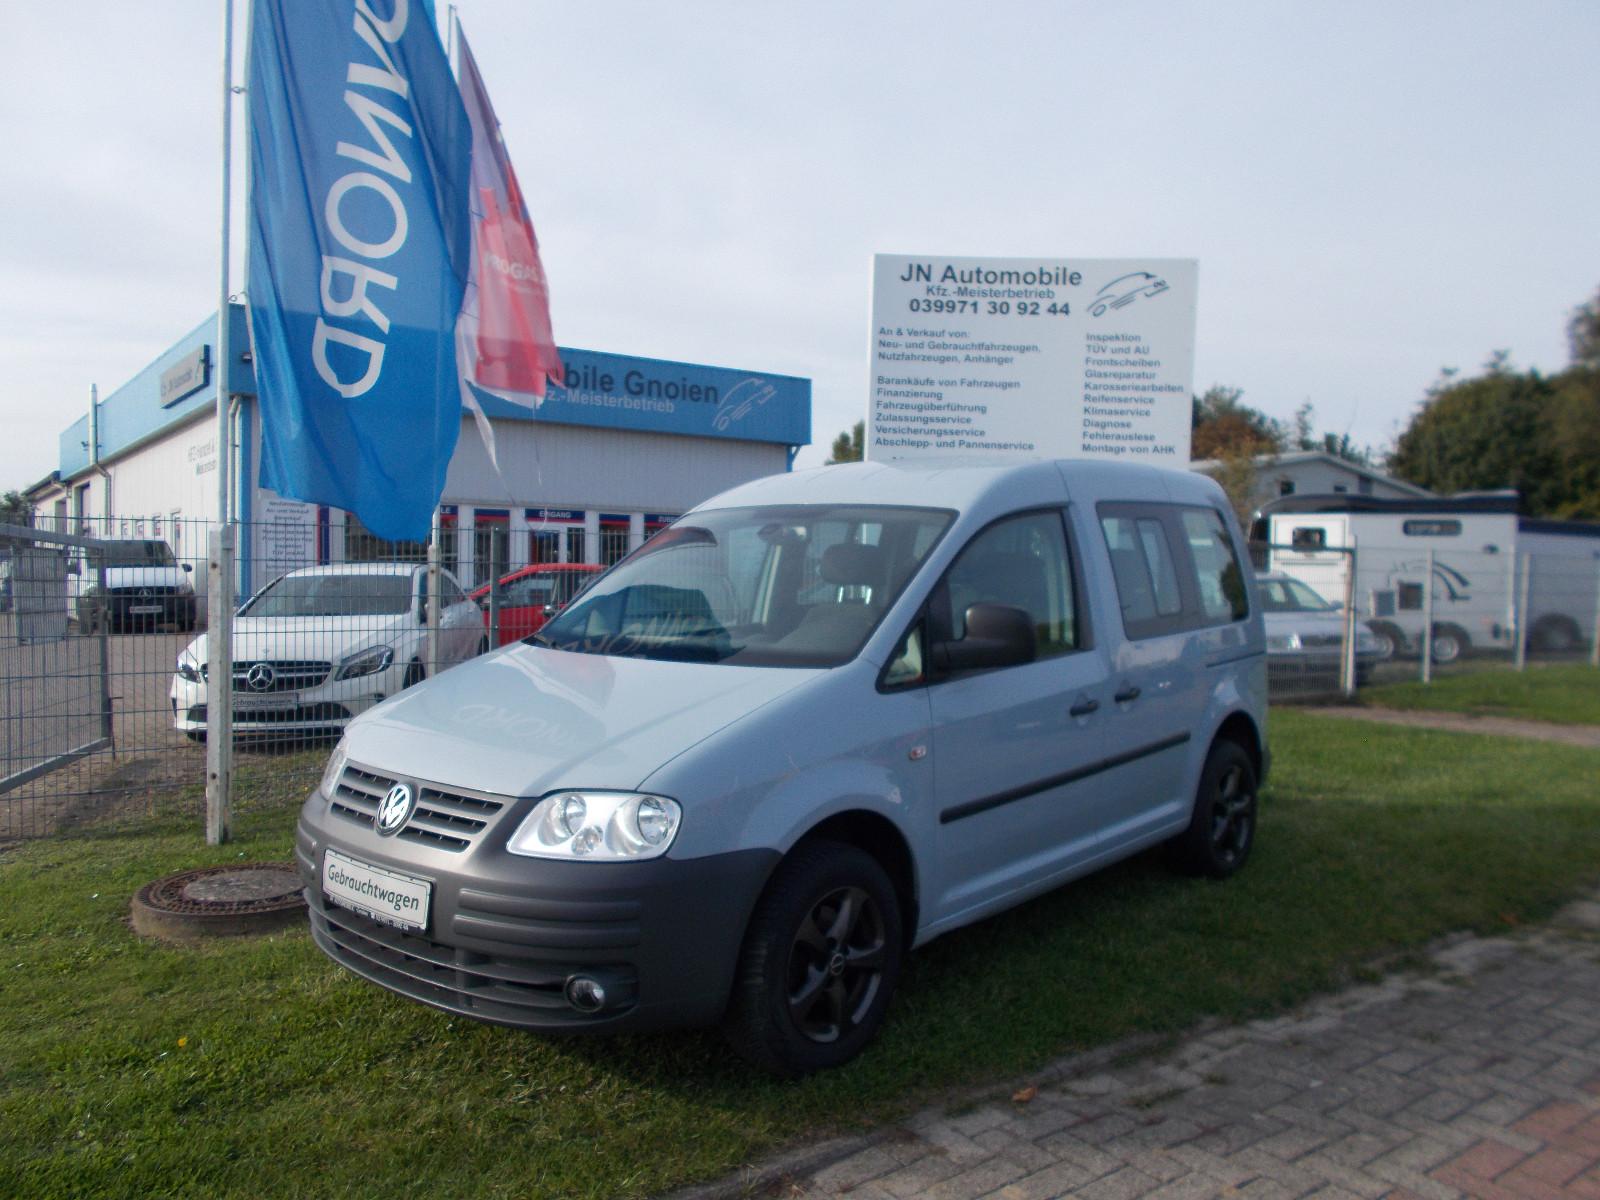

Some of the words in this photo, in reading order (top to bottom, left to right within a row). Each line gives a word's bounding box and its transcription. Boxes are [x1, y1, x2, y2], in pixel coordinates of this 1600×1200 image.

[900, 264, 932, 283] JN
[941, 265, 1083, 285] Automobile
[926, 286, 1055, 299] Kfz.-Meisterbetrieb
[910, 300, 979, 314] 039971
[988, 301, 1010, 315] 30
[1018, 302, 1039, 316] 92
[1048, 303, 1070, 317] 44
[879, 328, 893, 336] An
[896, 328, 903, 336] &
[907, 328, 945, 338] Verkauf
[1086, 333, 1141, 344] Inspektion
[879, 340, 902, 349] Neu-
[905, 341, 924, 349] und
[1086, 344, 1107, 354] TÜV
[1111, 345, 1130, 354] und
[964, 354, 1014, 365] Anhänger
[1085, 357, 1161, 367] Frontscheiben
[1085, 370, 1156, 381] Glasreparatur
[624, 369, 719, 403] Gnoien
[878, 376, 935, 387] Barankäufe
[938, 378, 957, 387] von
[961, 379, 1020, 390] Fahrzeugen
[1084, 383, 1184, 393] Karosseriearbeiten
[877, 388, 943, 400] Finanzierung
[1084, 394, 1155, 405] Reifenservice
[547, 389, 675, 413] z.-Meisterbetrieb
[876, 401, 988, 414] Fahrzeugüberführung
[1083, 406, 1151, 417] Klimaservice
[876, 413, 972, 425] Zulassungsservice
[1083, 419, 1132, 430] Diagnose
[876, 425, 986, 437] Versicherungsservice
[1082, 431, 1156, 442] Fehlerauslese
[875, 437, 934, 449] Abschlepp-
[937, 440, 955, 449] und
[958, 440, 1034, 451] Pannenservice
[1082, 443, 1126, 455] Montage
[1130, 445, 1149, 454] von
[1153, 445, 1176, 454] AHK
[328, 863, 420, 911] Gebrauchtwagen
